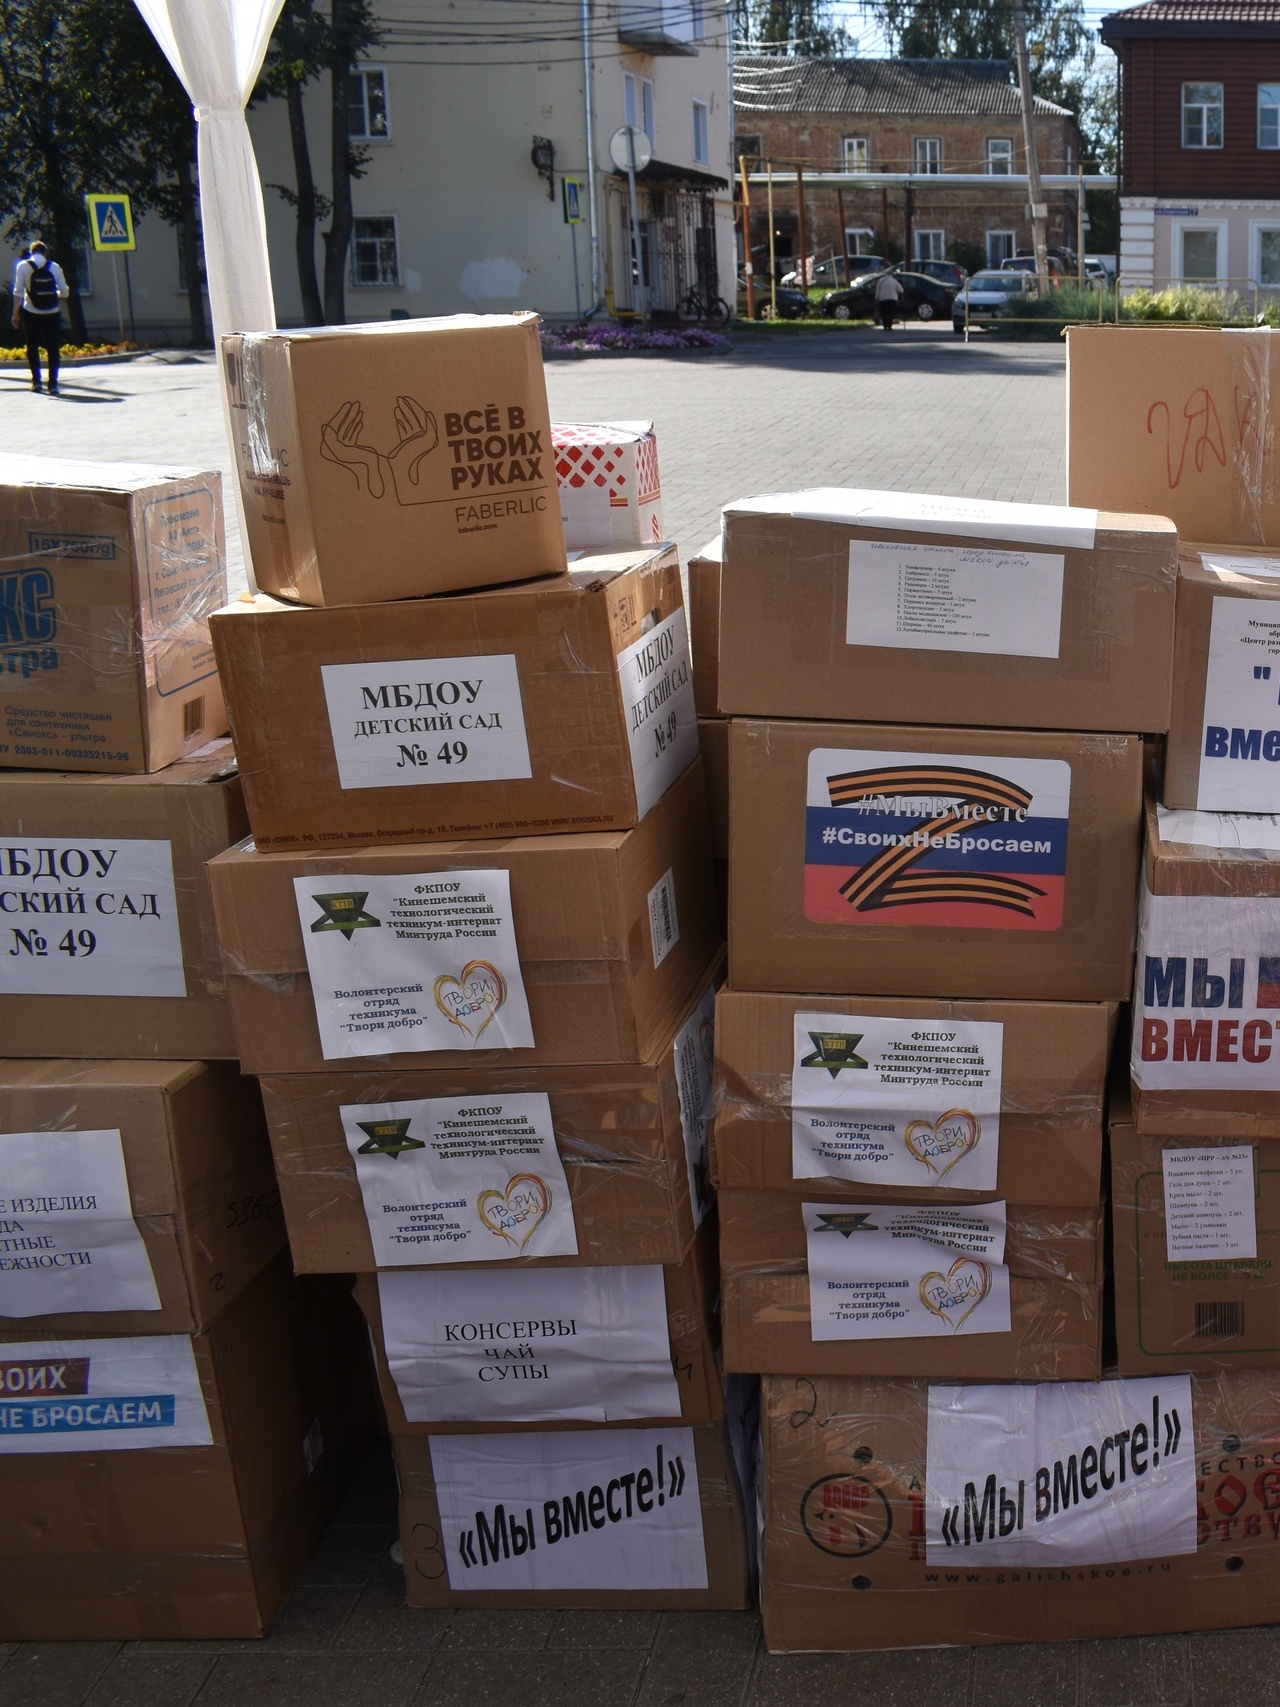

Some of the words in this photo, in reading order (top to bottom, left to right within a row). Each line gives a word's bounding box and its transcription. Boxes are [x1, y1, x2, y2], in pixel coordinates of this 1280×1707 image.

[505, 406, 526, 430] В
[447, 430, 543, 464] ТВОИХ
[450, 456, 543, 491] РУКАХ
[455, 496, 547, 523] FABERLIC
[458, 523, 498, 534] faberlic.com
[360, 679, 484, 711] МБДОУ
[5, 706, 56, 719] Средство
[59, 709, 112, 722] чистящее
[6, 717, 27, 728] для
[30, 718, 90, 731] сантехники
[355, 713, 454, 739] ДЕТСКИЙ
[459, 712, 502, 731] САД
[70, 731, 106, 743] ультра
[14, 745, 129, 762] 2383-011-00335215-96
[396, 743, 428, 767] №
[437, 740, 469, 765] 49
[858, 794, 1028, 823] #МыВместе
[822, 827, 1051, 853] #СвоихНеБросаем
[0, 848, 118, 884] БДОУ
[414, 882, 461, 895] ФКПОУ
[95, 893, 161, 920] САД
[390, 904, 494, 918] технологический
[386, 917, 502, 930] техникум-интернат
[395, 930, 454, 941] Минтруда
[455, 929, 497, 938] России
[10, 928, 48, 956] №
[59, 929, 97, 957] 49
[334, 983, 424, 999] Волонтерский
[1144, 956, 1245, 1008] МЫ
[349, 1006, 417, 1021] техникума
[363, 997, 400, 1010] отряд
[11, 1195, 97, 1214] ИЗДЕЛИЯ
[444, 1319, 578, 1342] КОНСЕРВЫ
[484, 1343, 535, 1360] ЧАЙ
[478, 1364, 550, 1382] СУПЫ
[33, 1401, 162, 1428] БРОСАЕМ
[942, 1473, 1025, 1547] «Мы
[1036, 1395, 1182, 1523] вместе!»
[459, 1504, 536, 1568] «Мы
[543, 1444, 686, 1545] вместе!»
[925, 1564, 1171, 1584] www.galichskoe.ru
